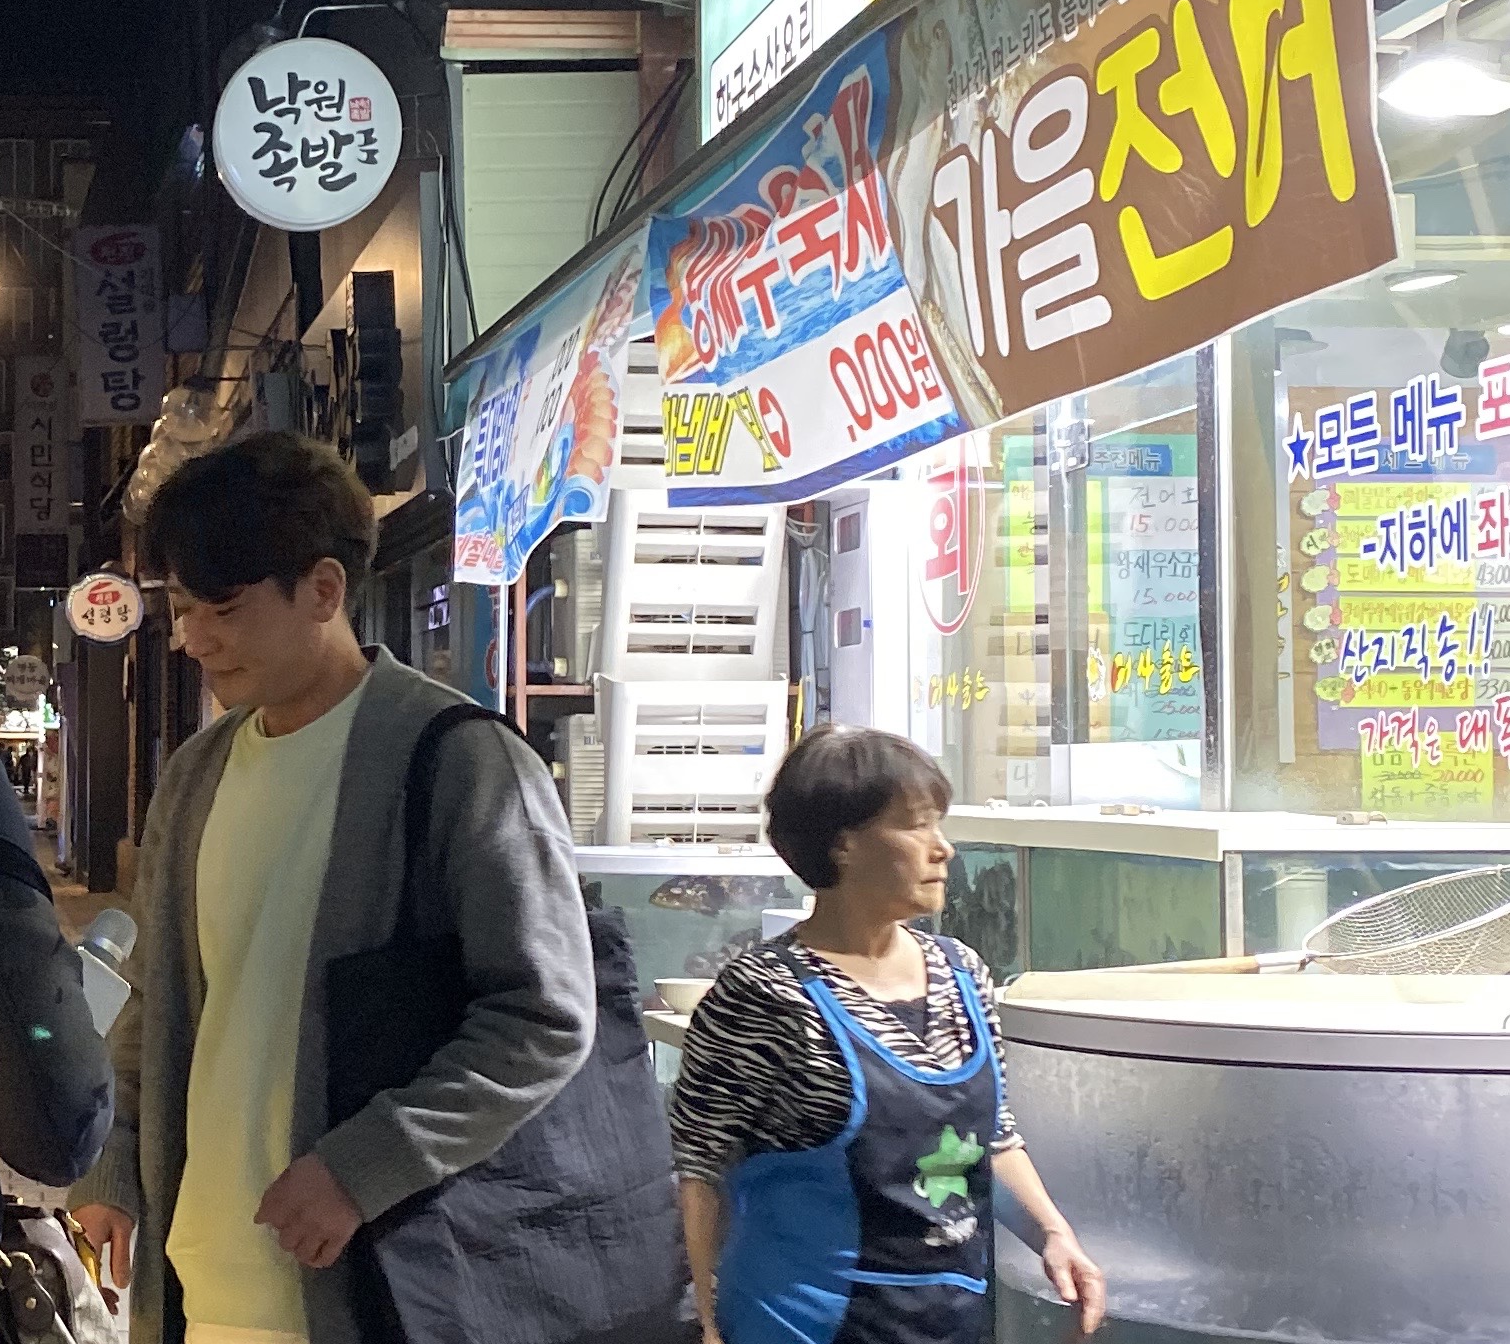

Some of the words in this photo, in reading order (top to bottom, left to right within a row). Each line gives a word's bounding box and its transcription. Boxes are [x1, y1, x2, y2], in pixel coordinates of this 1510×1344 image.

[247, 72, 346, 124] 낙원
[252, 122, 357, 192] 족발
[96, 269, 145, 412] 설렁탕
[1316, 396, 1378, 473] 모든
[1394, 379, 1462, 456] 메뉴
[1360, 710, 1441, 766] 가격은
